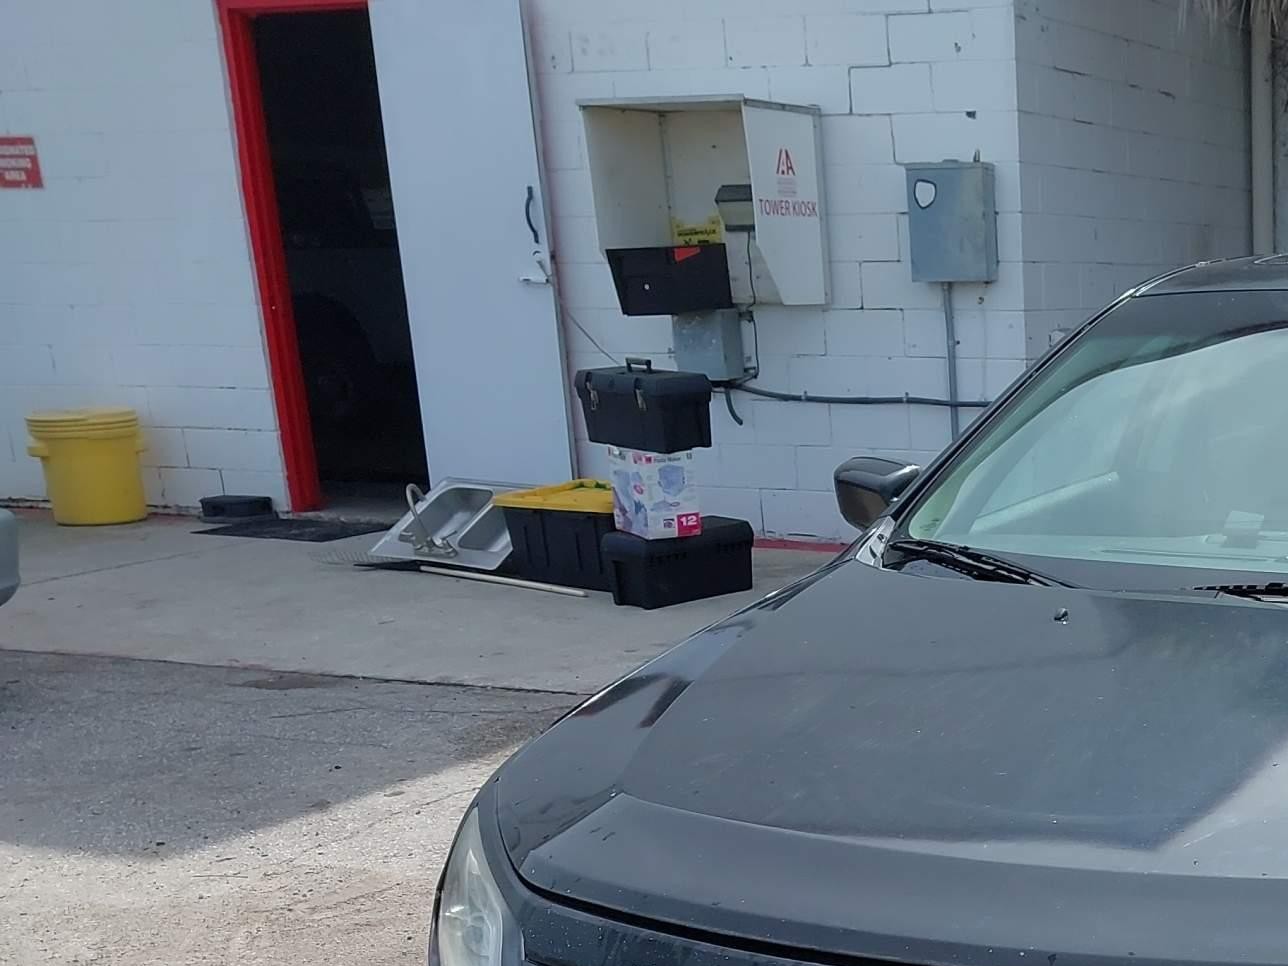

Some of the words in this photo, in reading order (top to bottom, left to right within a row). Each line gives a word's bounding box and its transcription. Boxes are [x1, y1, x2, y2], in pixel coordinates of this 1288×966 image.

[759, 198, 790, 216] TOWER
[792, 200, 818, 217] KIOSK
[680, 516, 698, 527] 12
